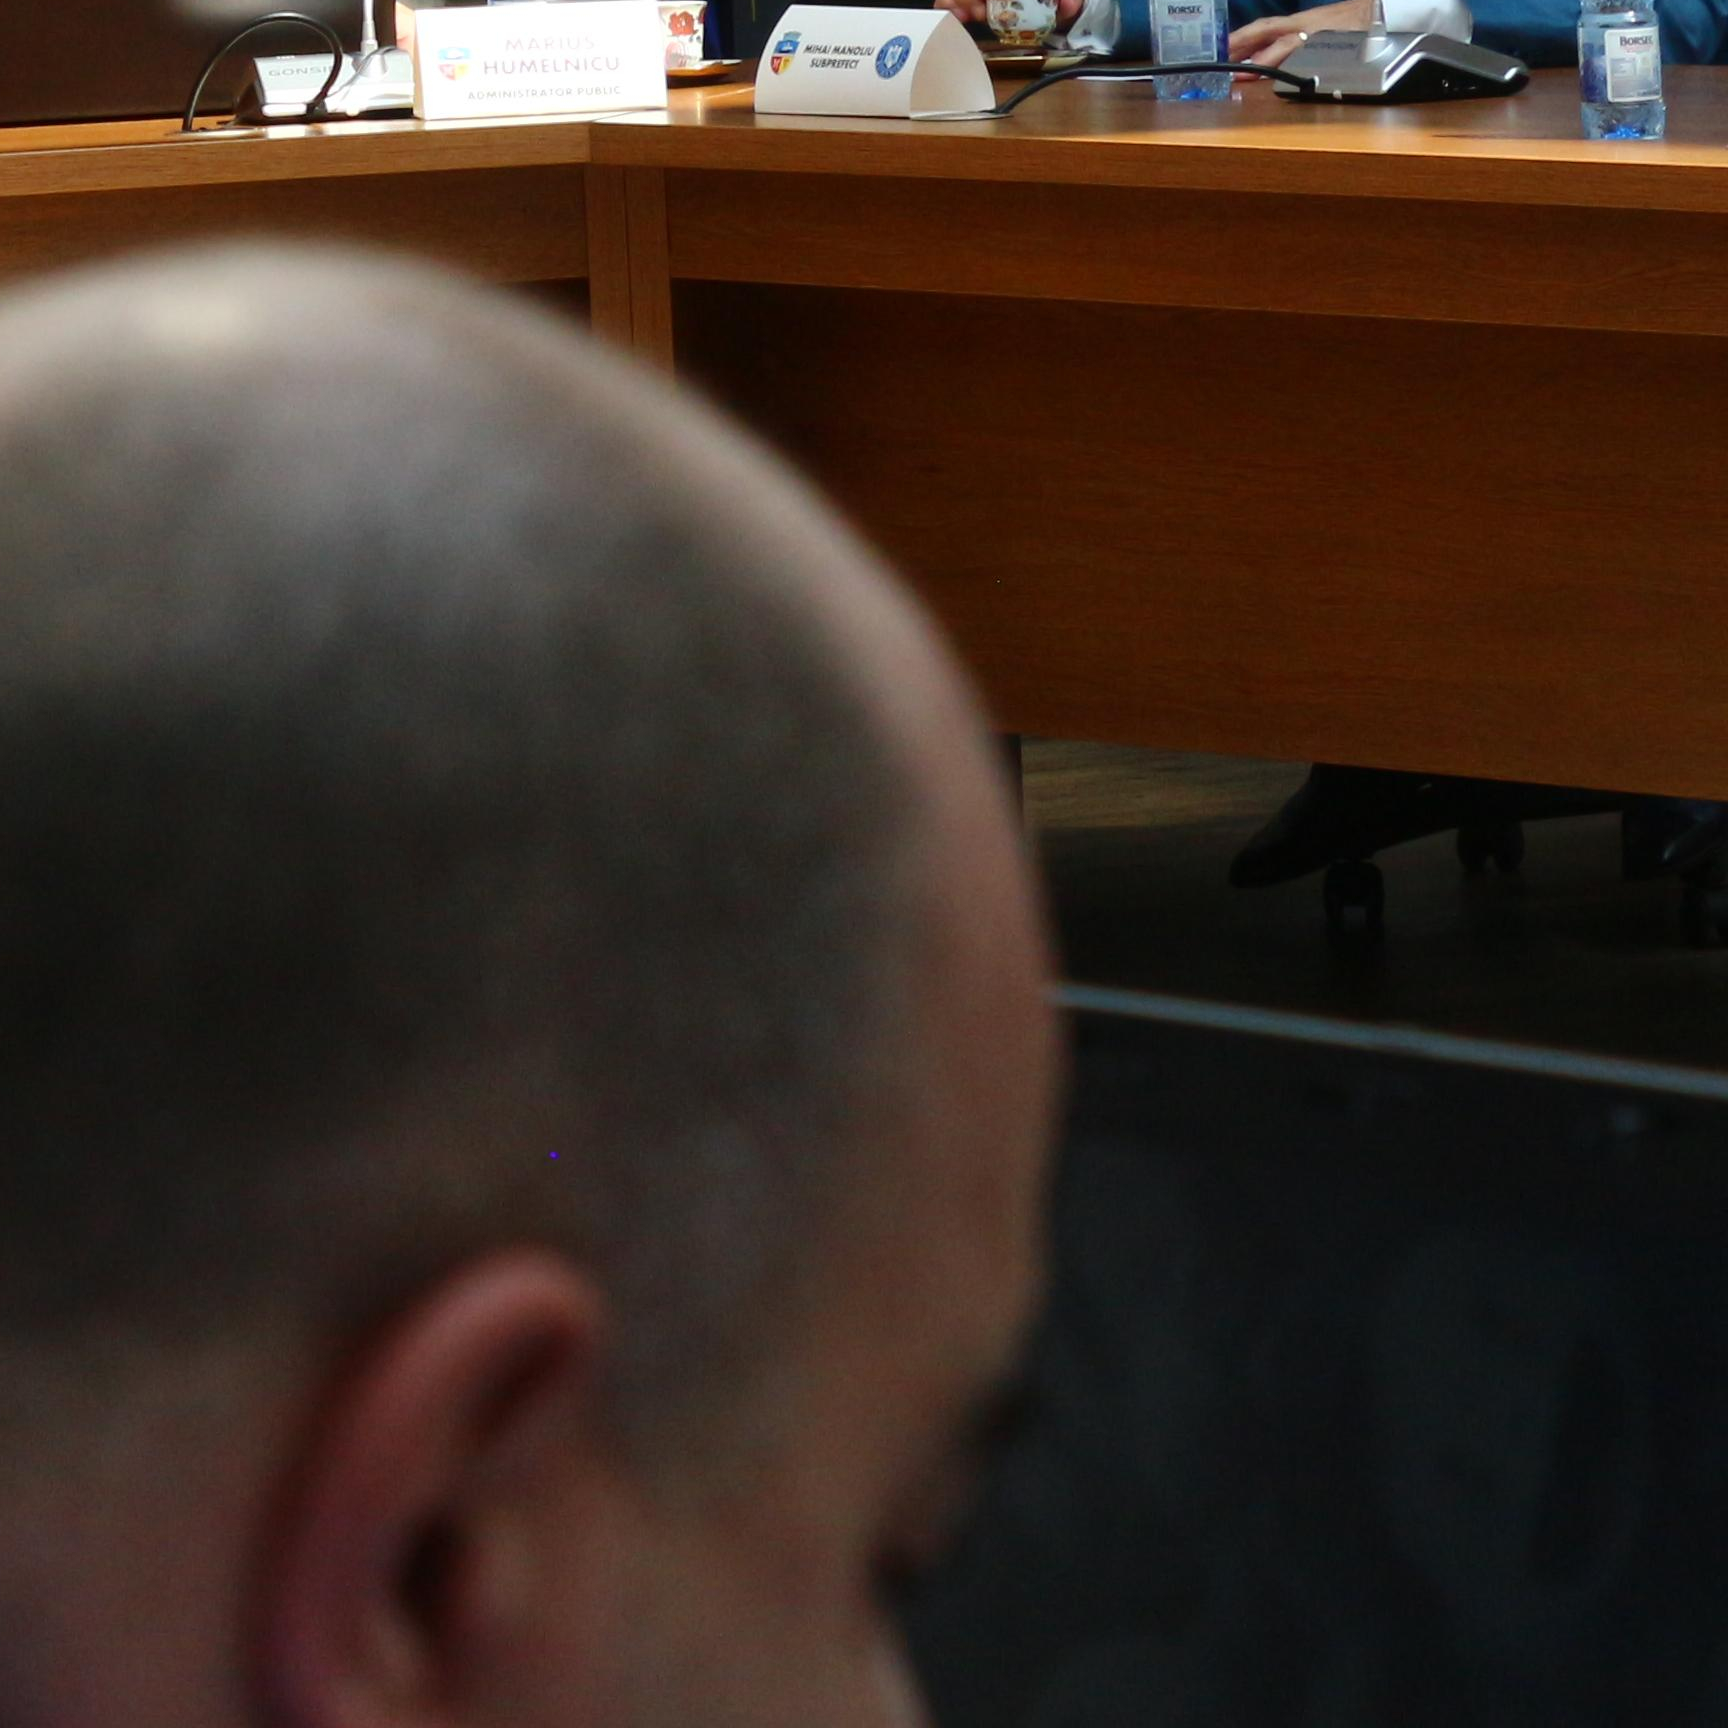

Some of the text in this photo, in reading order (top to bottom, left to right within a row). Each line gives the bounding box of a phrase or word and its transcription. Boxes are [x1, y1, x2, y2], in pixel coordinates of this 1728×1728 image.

[505, 35, 595, 52] MARIUS
[803, 44, 876, 56] MIHAI MANOLIU
[483, 56, 620, 75] HUMELNICU
[809, 58, 860, 70] SUBPREFECT
[468, 85, 622, 101] ADMINISTRATOR PUBLIC
